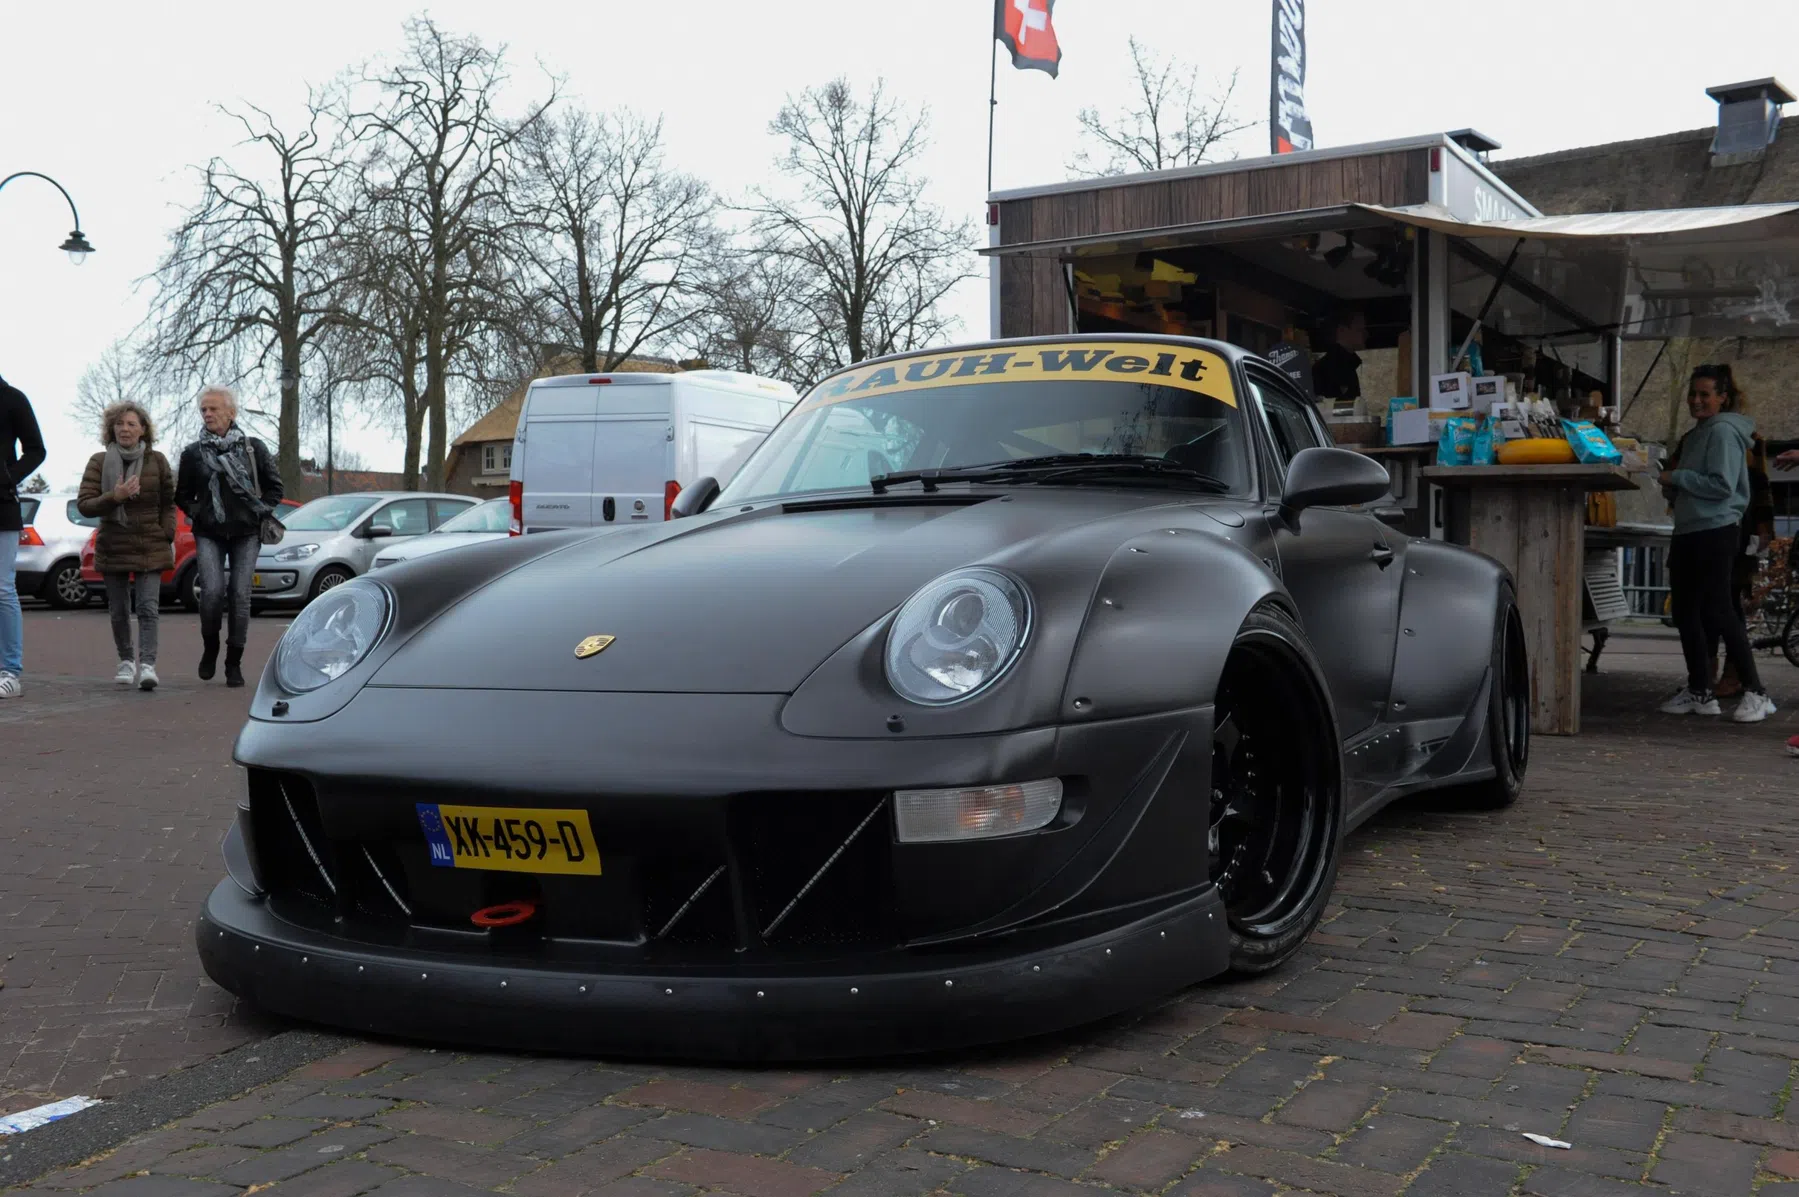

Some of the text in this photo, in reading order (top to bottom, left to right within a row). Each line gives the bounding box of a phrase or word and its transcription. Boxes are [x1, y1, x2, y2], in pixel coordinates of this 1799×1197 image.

[813, 349, 1207, 402] RAUH-Welt
[432, 843, 451, 860] NL
[444, 815, 585, 862] XK-459-D
